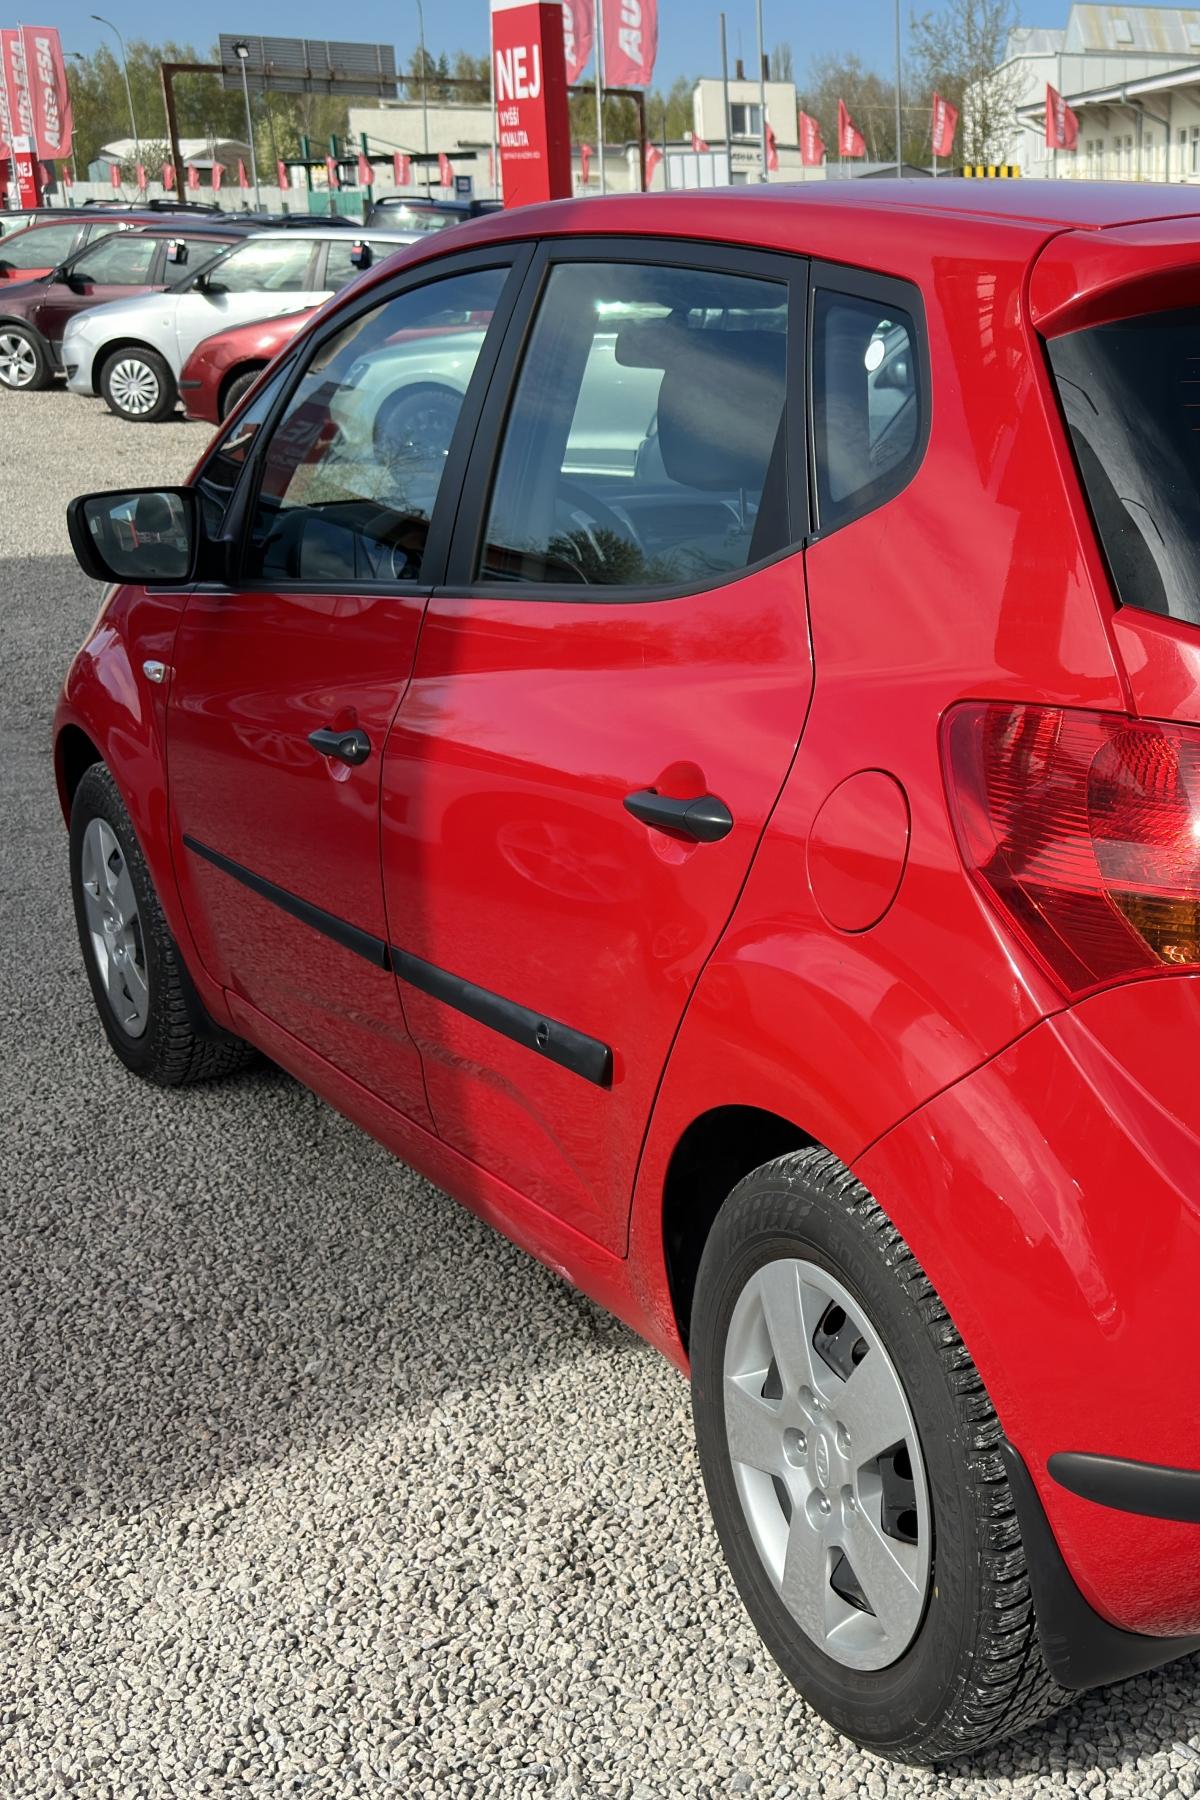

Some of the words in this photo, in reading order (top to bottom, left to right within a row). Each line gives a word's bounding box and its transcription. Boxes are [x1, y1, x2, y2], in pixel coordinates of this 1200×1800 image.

[35, 37, 55, 87] ESA
[496, 44, 541, 101] NEJ
[44, 88, 60, 148] Auto
[501, 131, 529, 148] KVALITA
[16, 162, 33, 178] NEJ
